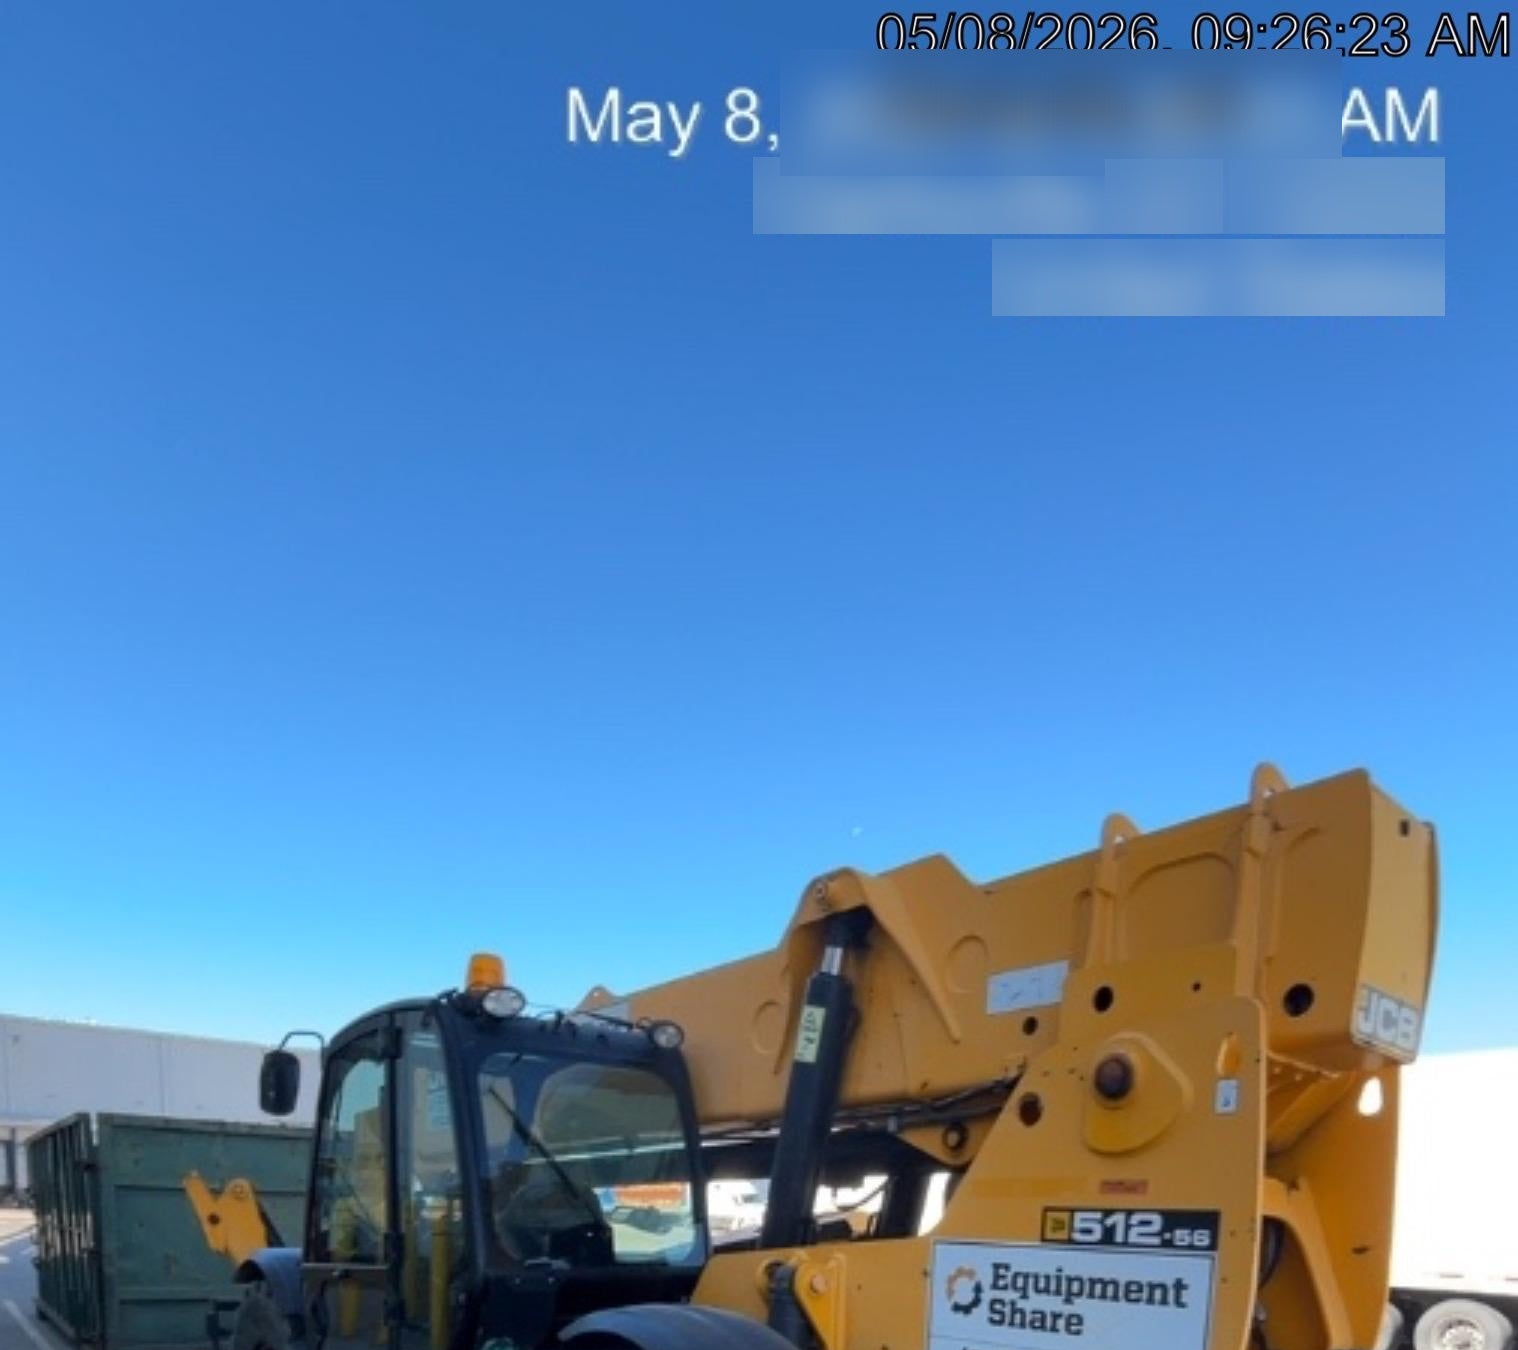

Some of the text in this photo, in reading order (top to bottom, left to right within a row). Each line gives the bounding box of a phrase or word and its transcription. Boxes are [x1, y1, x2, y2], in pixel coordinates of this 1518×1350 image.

[1357, 990, 1417, 1052] JCB
[990, 1262, 1190, 1308] Equipment
[987, 1299, 1085, 1336] Share
